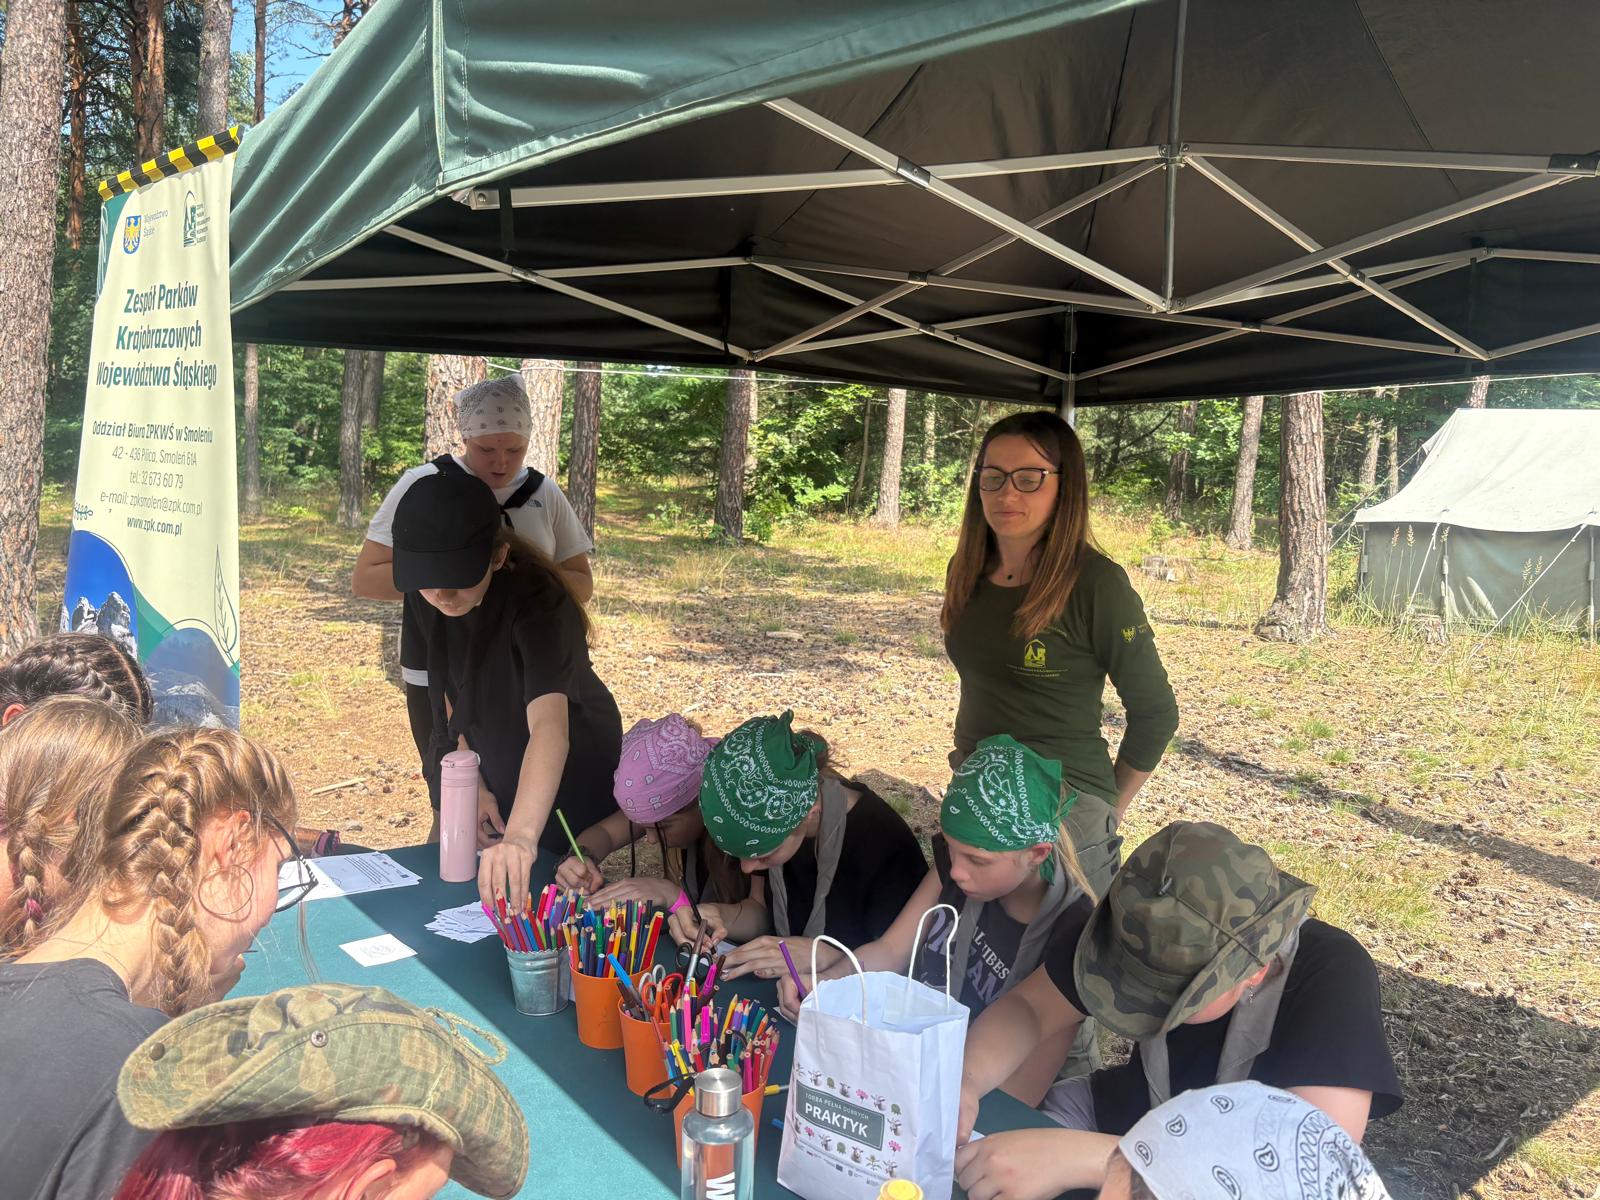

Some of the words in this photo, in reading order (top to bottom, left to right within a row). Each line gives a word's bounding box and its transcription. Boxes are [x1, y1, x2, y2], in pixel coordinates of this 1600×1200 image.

[124, 285, 156, 316] Zespół
[157, 281, 199, 310] Parków
[116, 320, 202, 353] Krajobrazowych
[96, 361, 171, 388] Województwa
[173, 357, 217, 391] Śląskiego
[92, 420, 126, 437] Oddział
[128, 423, 145, 438] Biuro
[145, 422, 175, 441] ZPKWŚ
[176, 428, 183, 441] w
[183, 425, 213, 443] Smoleniu
[112, 446, 124, 460] 42
[149, 471, 161, 487] 673
[163, 472, 173, 488] 60
[175, 473, 184, 489] 79
[100, 491, 129, 505] e-mail:
[127, 517, 183, 537] www.zpk.com.pl
[805, 1102, 869, 1138] PRAKTYK
[843, 1105, 869, 1120] DOBRYCH
